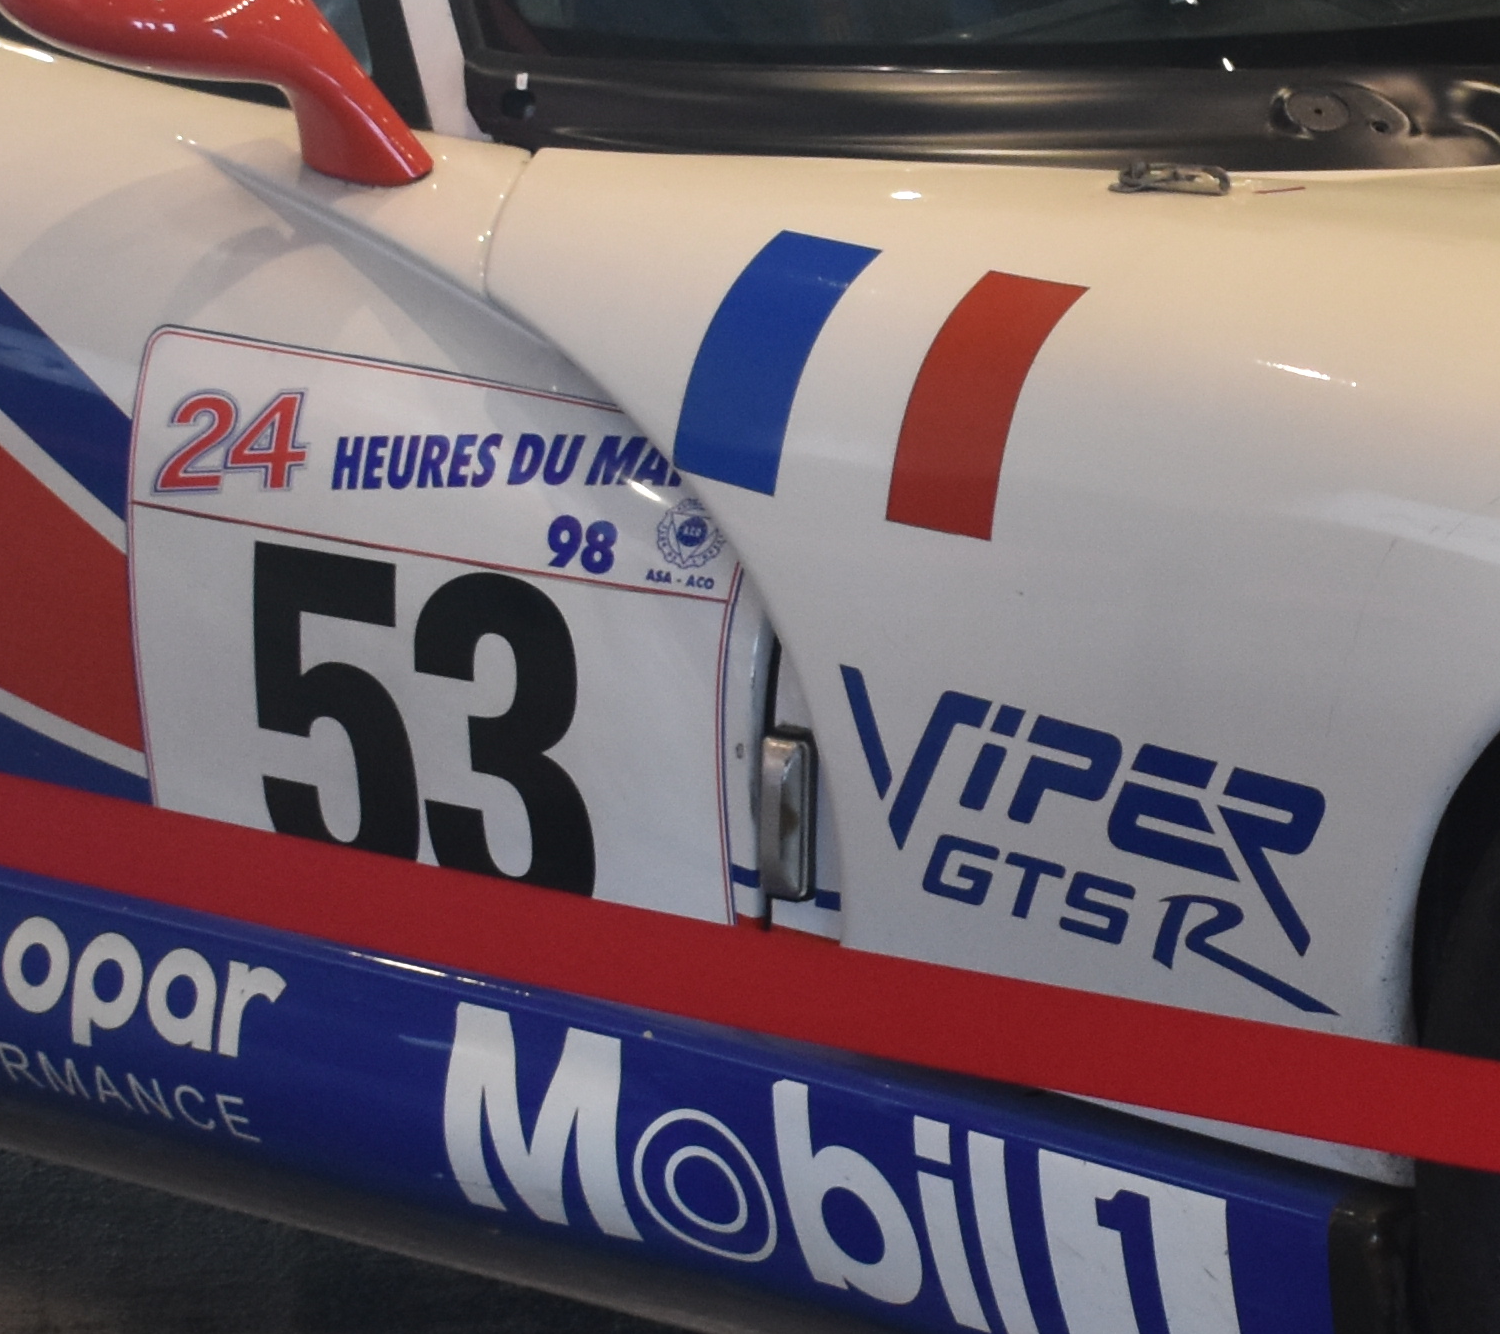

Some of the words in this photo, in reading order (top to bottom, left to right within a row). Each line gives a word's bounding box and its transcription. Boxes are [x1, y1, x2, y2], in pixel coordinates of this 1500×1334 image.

[152, 387, 310, 496] 24
[331, 433, 502, 490] HEURES
[506, 432, 587, 486] DU
[583, 434, 682, 487] MA
[546, 514, 619, 575] 98
[253, 540, 596, 899] 53
[839, 664, 1326, 957] VIPER
[922, 833, 1136, 945] GTS
[1152, 894, 1341, 1016] R
